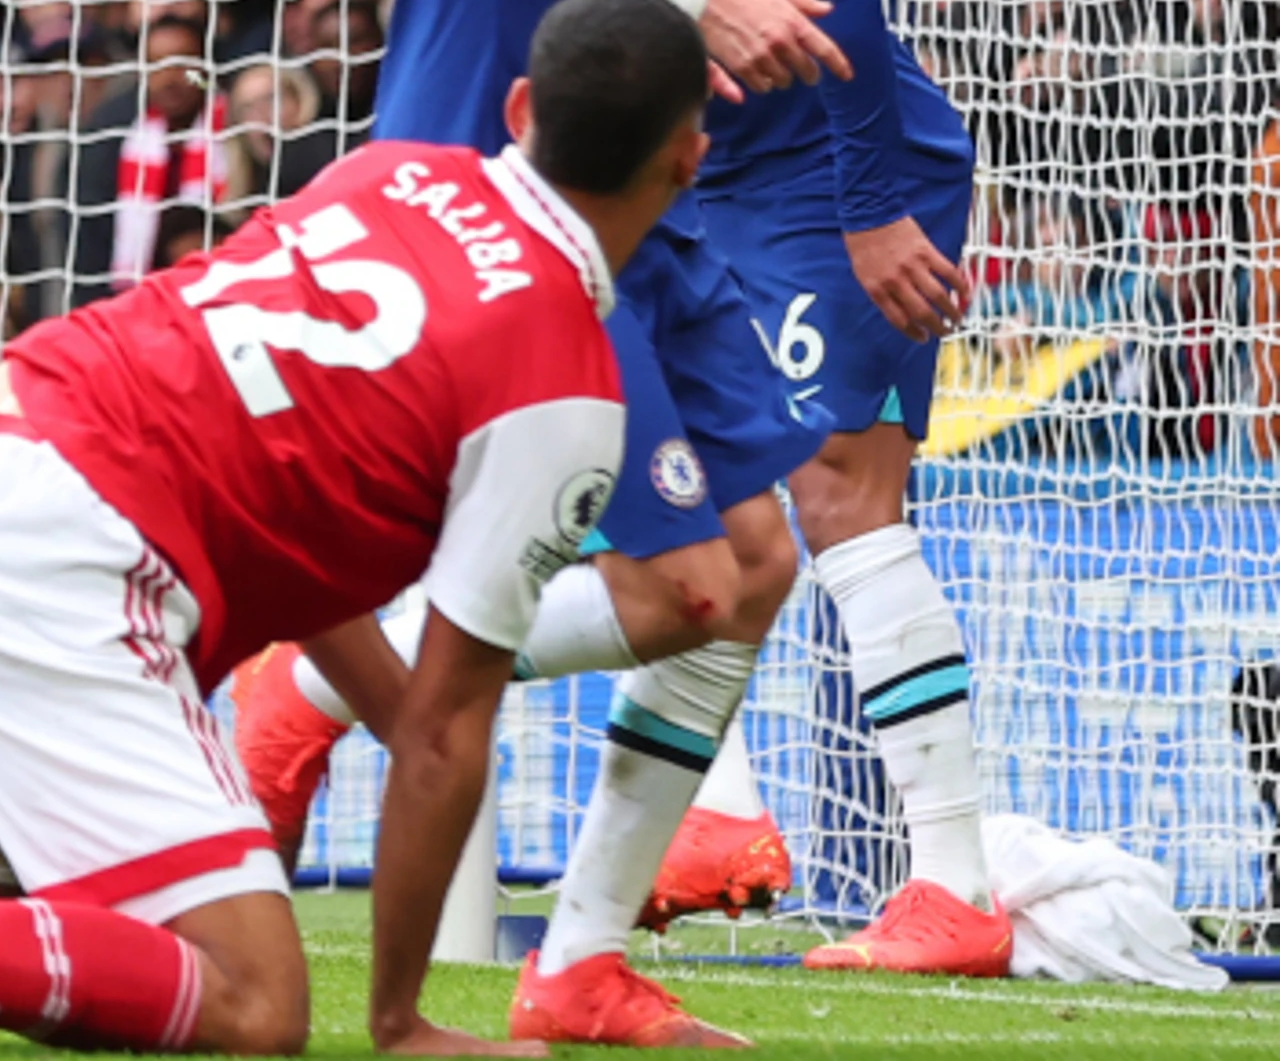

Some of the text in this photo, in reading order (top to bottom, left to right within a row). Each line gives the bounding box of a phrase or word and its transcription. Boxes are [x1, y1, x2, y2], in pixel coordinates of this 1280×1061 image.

[382, 161, 533, 304] SALIBA
[180, 203, 427, 419] 12
[778, 293, 825, 382] 6
